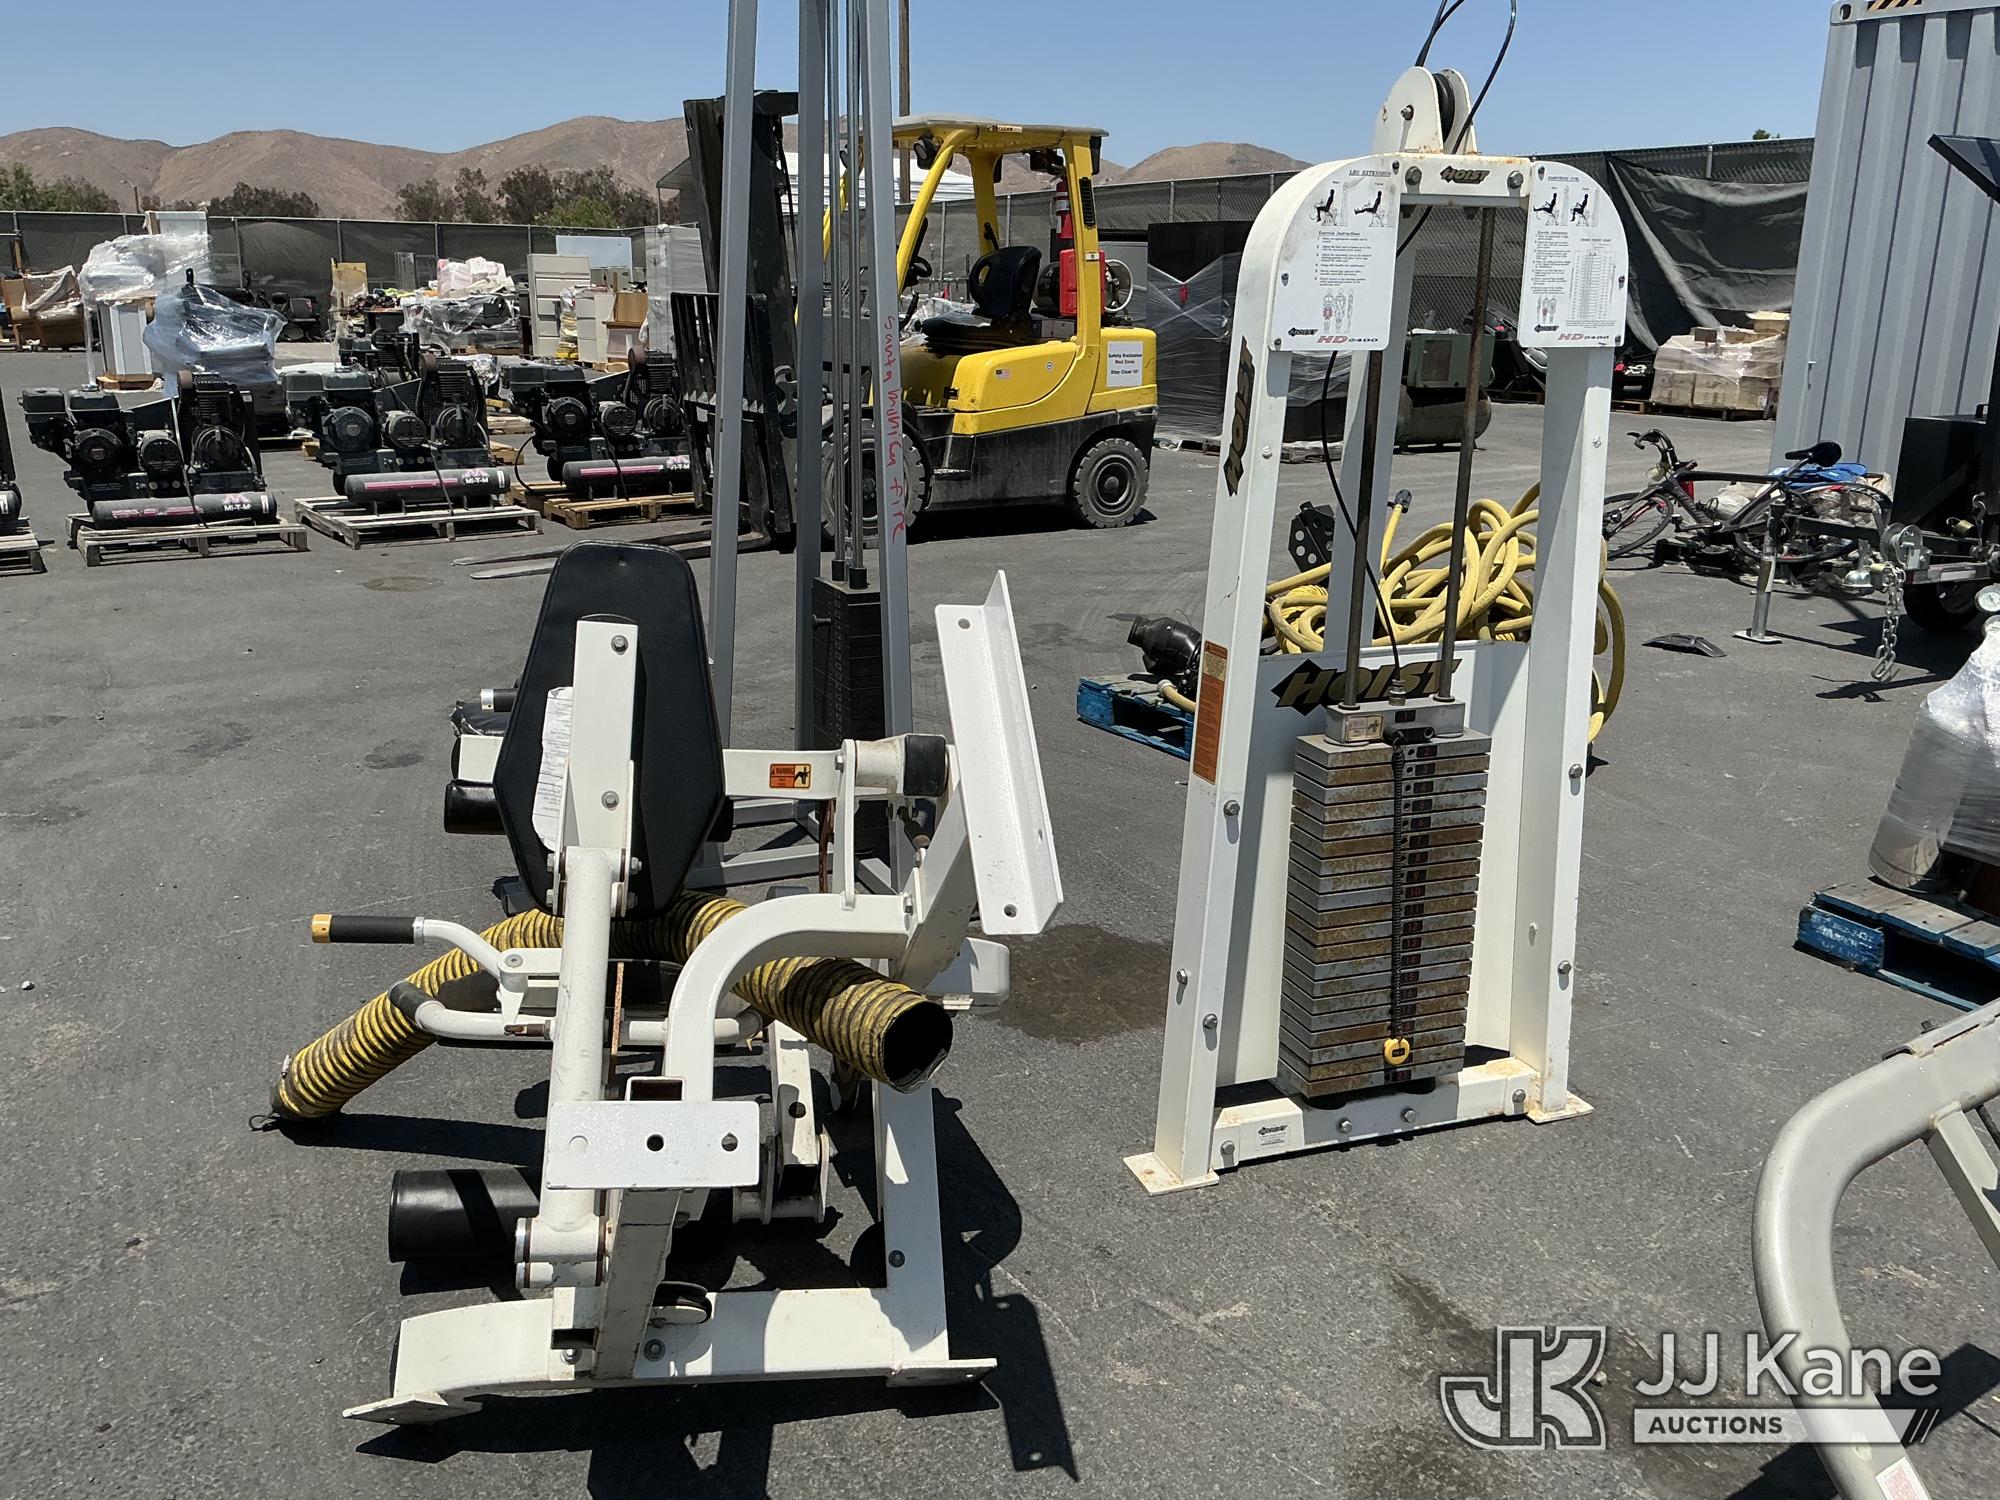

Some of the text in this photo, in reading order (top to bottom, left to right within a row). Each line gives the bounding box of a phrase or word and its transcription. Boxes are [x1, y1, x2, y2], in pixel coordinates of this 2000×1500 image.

[1441, 166, 1490, 183] HOIST
[1225, 337, 1255, 494] HOIST
[1278, 660, 1462, 706] HOIST
[1410, 887, 1421, 896] 10
